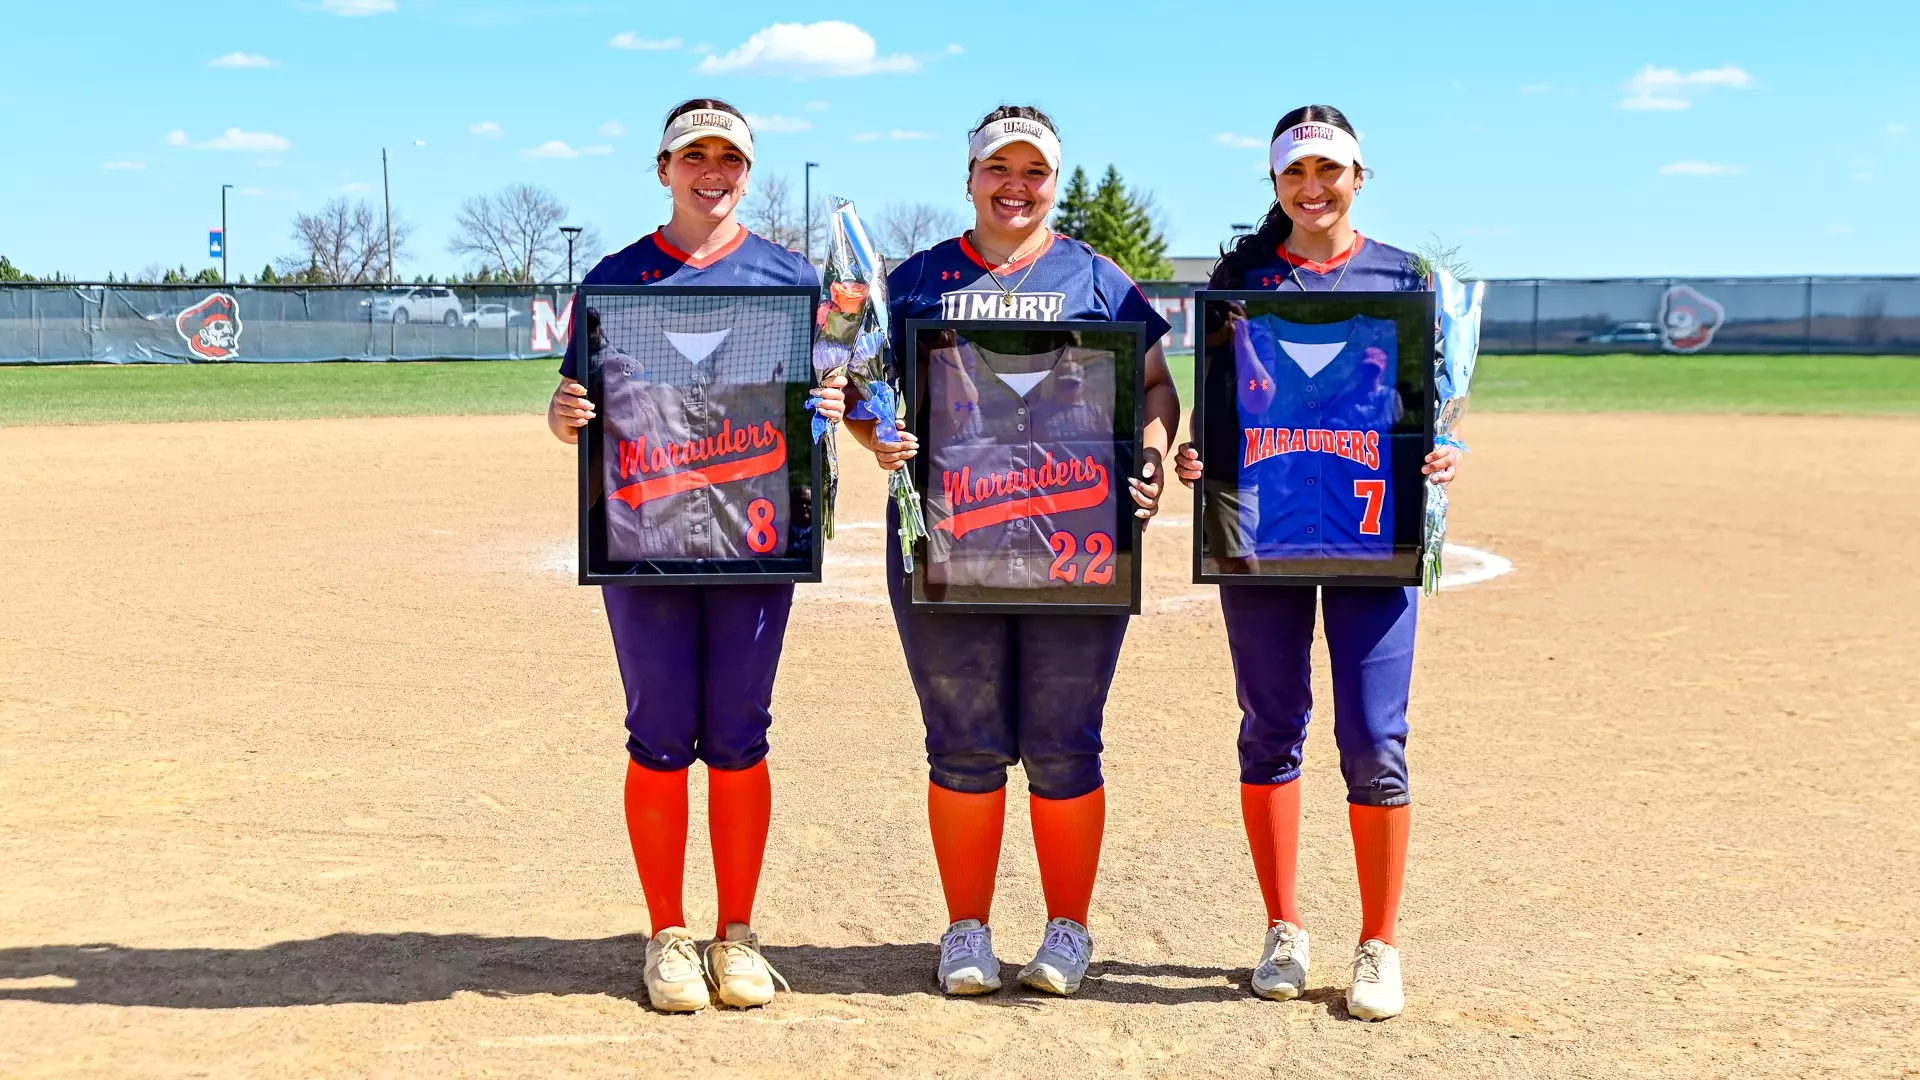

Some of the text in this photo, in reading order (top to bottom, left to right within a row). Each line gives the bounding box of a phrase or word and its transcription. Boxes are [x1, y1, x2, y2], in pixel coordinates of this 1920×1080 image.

[619, 418, 776, 480] Marauders
[1243, 428, 1380, 471] MARAUDERS
[943, 451, 1098, 511] Marauders
[1353, 480, 1386, 536] 7
[745, 498, 778, 553] 8
[1048, 530, 1114, 585] 22
